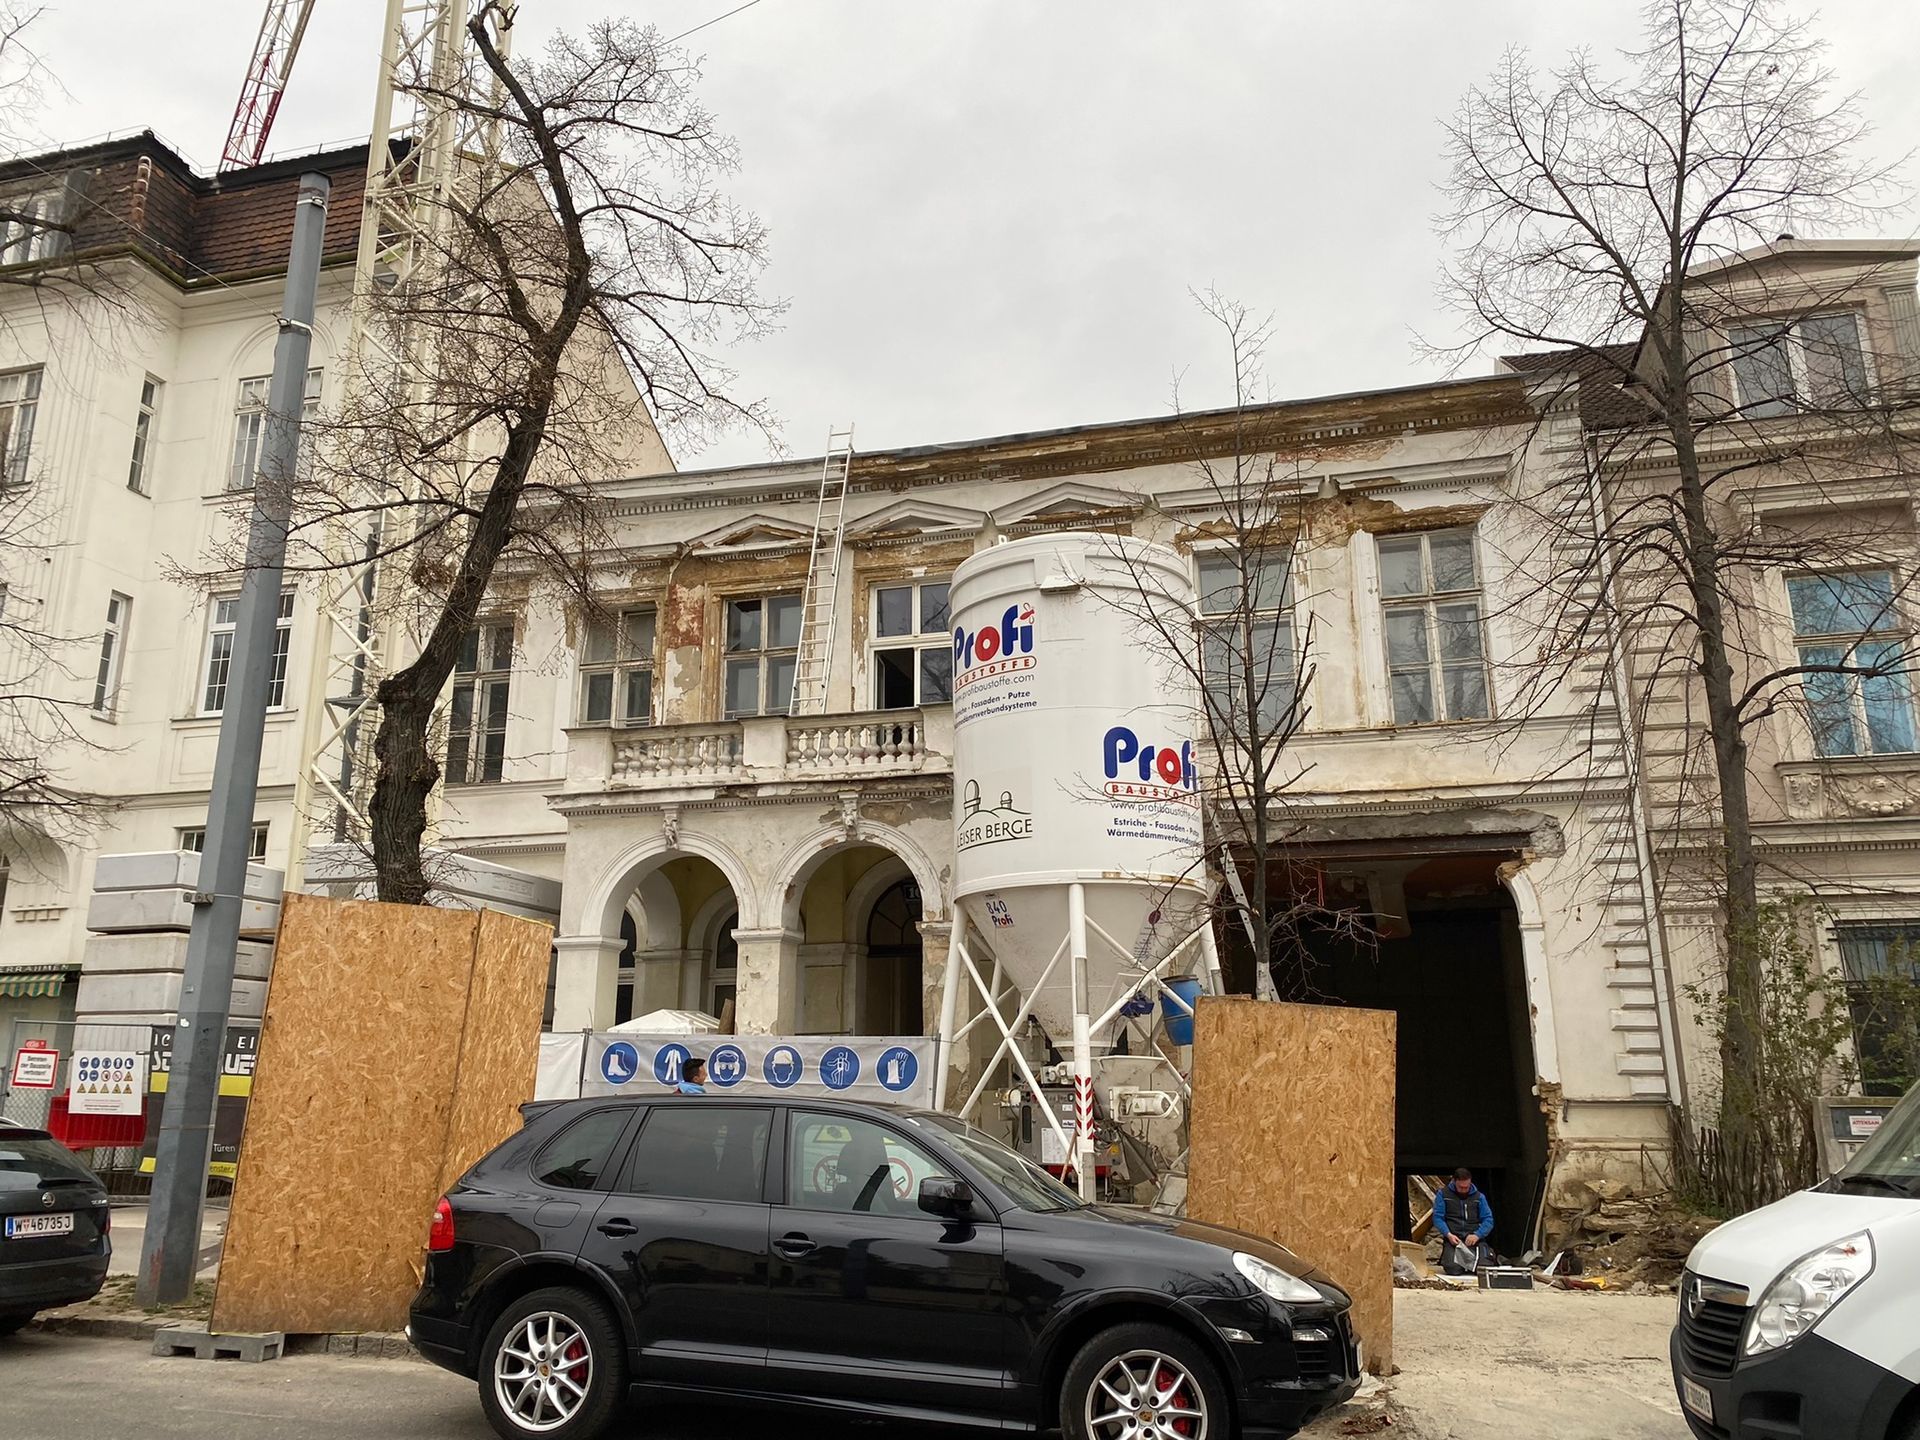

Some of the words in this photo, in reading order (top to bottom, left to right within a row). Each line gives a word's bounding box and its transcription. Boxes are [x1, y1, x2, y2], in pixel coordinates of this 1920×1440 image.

[954, 603, 1035, 678] Profi
[1008, 690, 1031, 699] Putze
[1103, 727, 1197, 792] Profi
[986, 819, 1033, 839] BERGE
[1114, 818, 1147, 827] Estriche
[1155, 821, 1186, 833] Fassaden
[15, 1220, 22, 1232] W
[31, 1216, 70, 1230] 46735J
